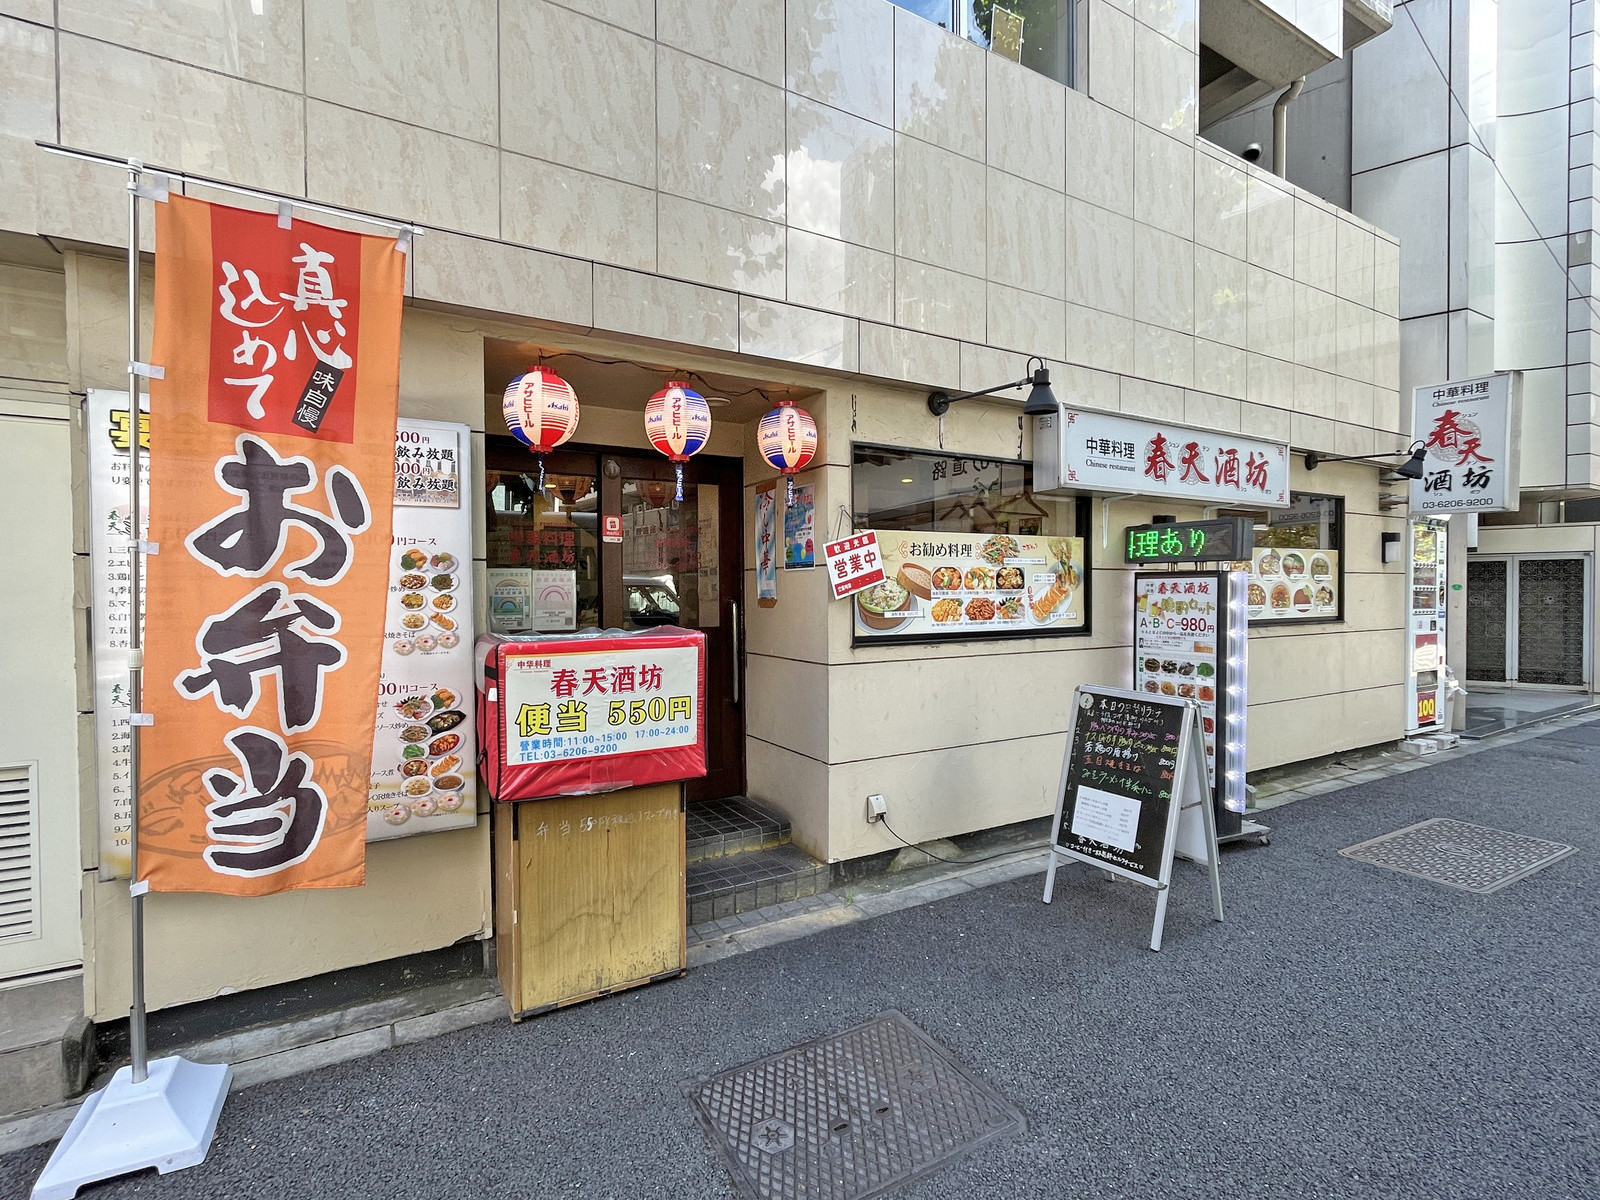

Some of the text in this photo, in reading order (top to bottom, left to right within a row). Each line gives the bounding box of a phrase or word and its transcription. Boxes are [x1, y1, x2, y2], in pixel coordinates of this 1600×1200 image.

[280, 242, 353, 371] 真心
[219, 261, 285, 420] 込めて
[296, 369, 336, 431] 味自慢
[523, 382, 535, 428] アサヒビール
[1431, 400, 1457, 408] Chinese
[1432, 381, 1489, 401] 中華料理
[547, 402, 569, 411] Asahi
[671, 397, 682, 440] アサヒビール
[786, 414, 797, 454] アサヒビール
[1086, 436, 1135, 460] 中華料理
[1425, 409, 1495, 468] 春天
[1085, 459, 1136, 473] Chinese restaurant
[1144, 432, 1270, 492] 春天酒坊
[1424, 466, 1494, 493] 酒坊
[1422, 497, 1494, 509] 03-6206-9200
[833, 549, 877, 579] 営業中
[909, 541, 973, 558] お勧め料理
[1157, 581, 1211, 596] 春天酒坊
[174, 433, 371, 877] お弁当
[549, 663, 665, 698] 春天酒坊
[514, 695, 693, 738] 便当 550円
[634, 725, 690, 740] 17:00~24:00
[519, 743, 619, 762] TEL:03-6206-9200
